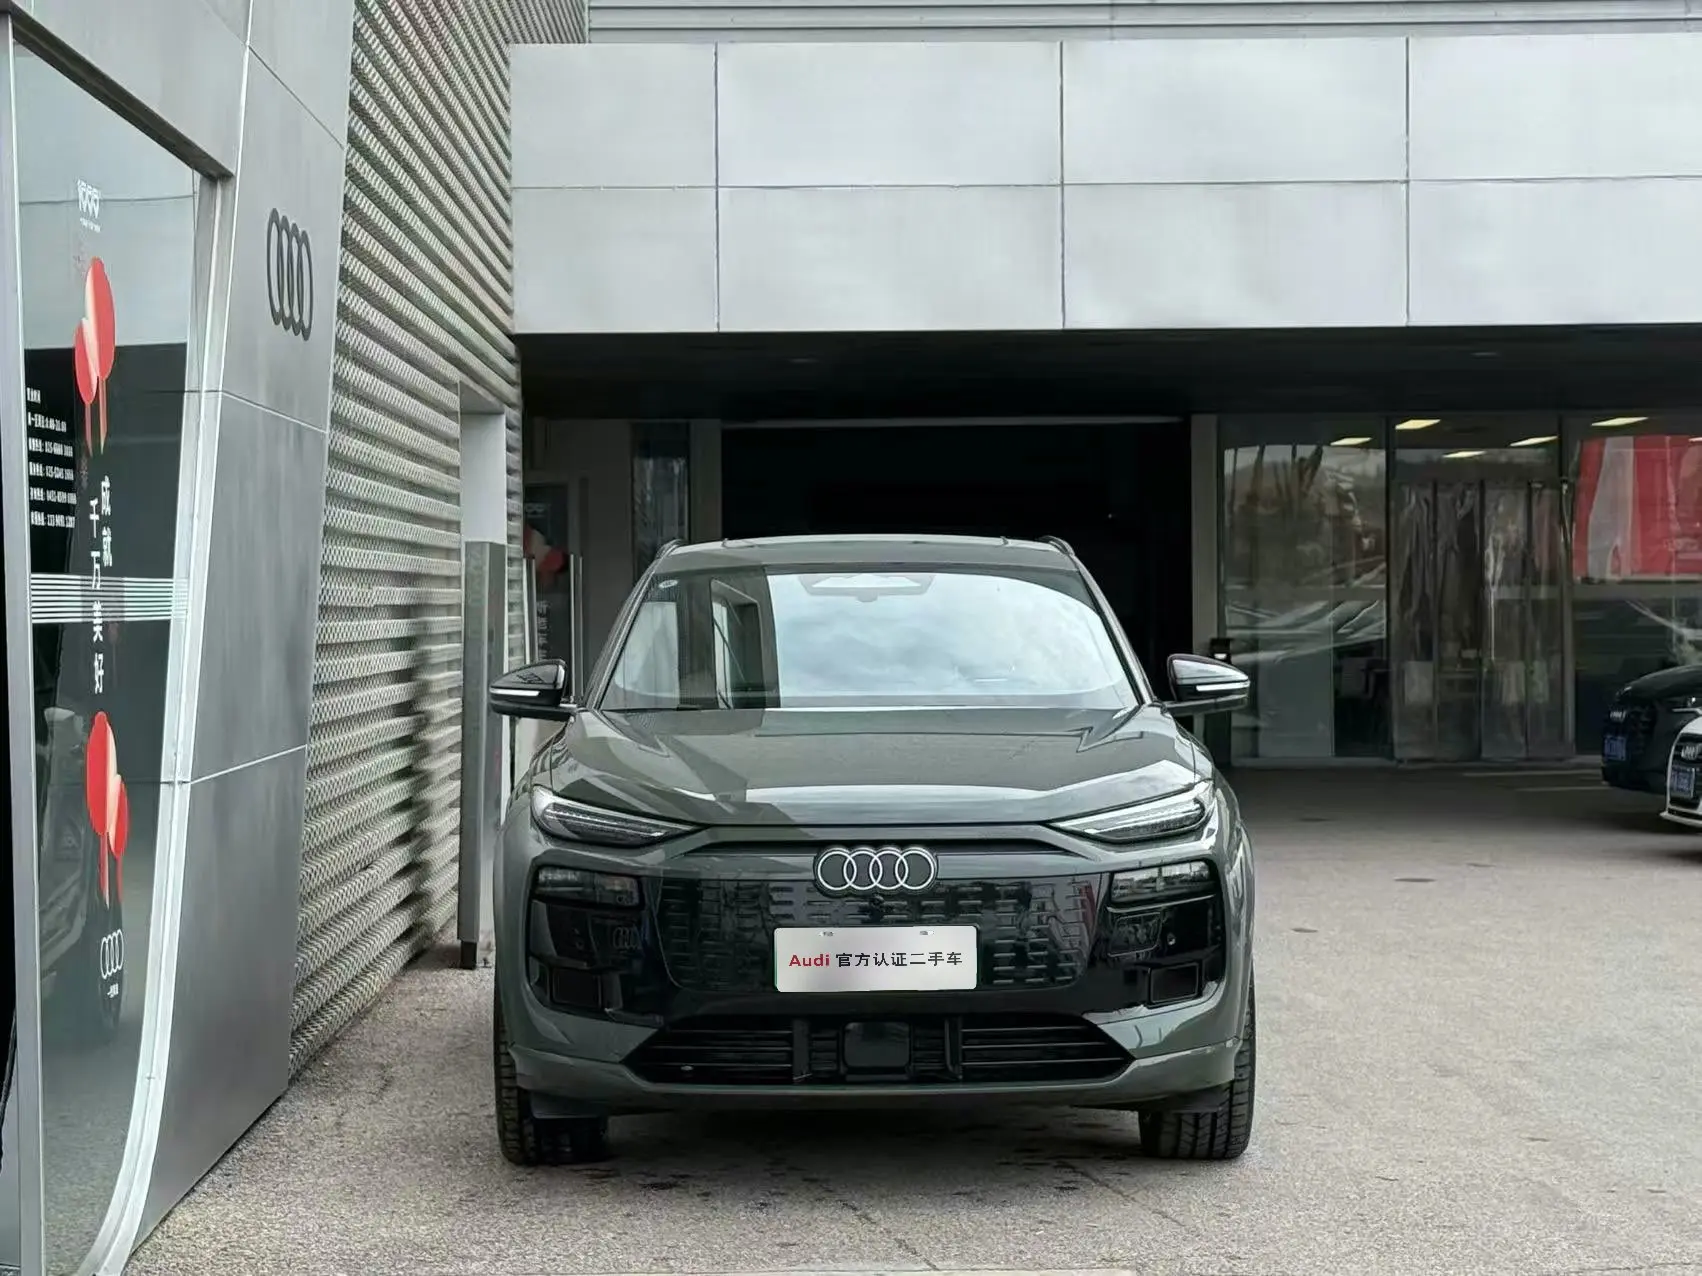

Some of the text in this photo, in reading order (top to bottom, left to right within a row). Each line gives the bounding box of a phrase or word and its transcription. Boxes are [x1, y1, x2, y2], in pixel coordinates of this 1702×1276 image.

[789, 952, 963, 967] Audi 官方认证二手车
